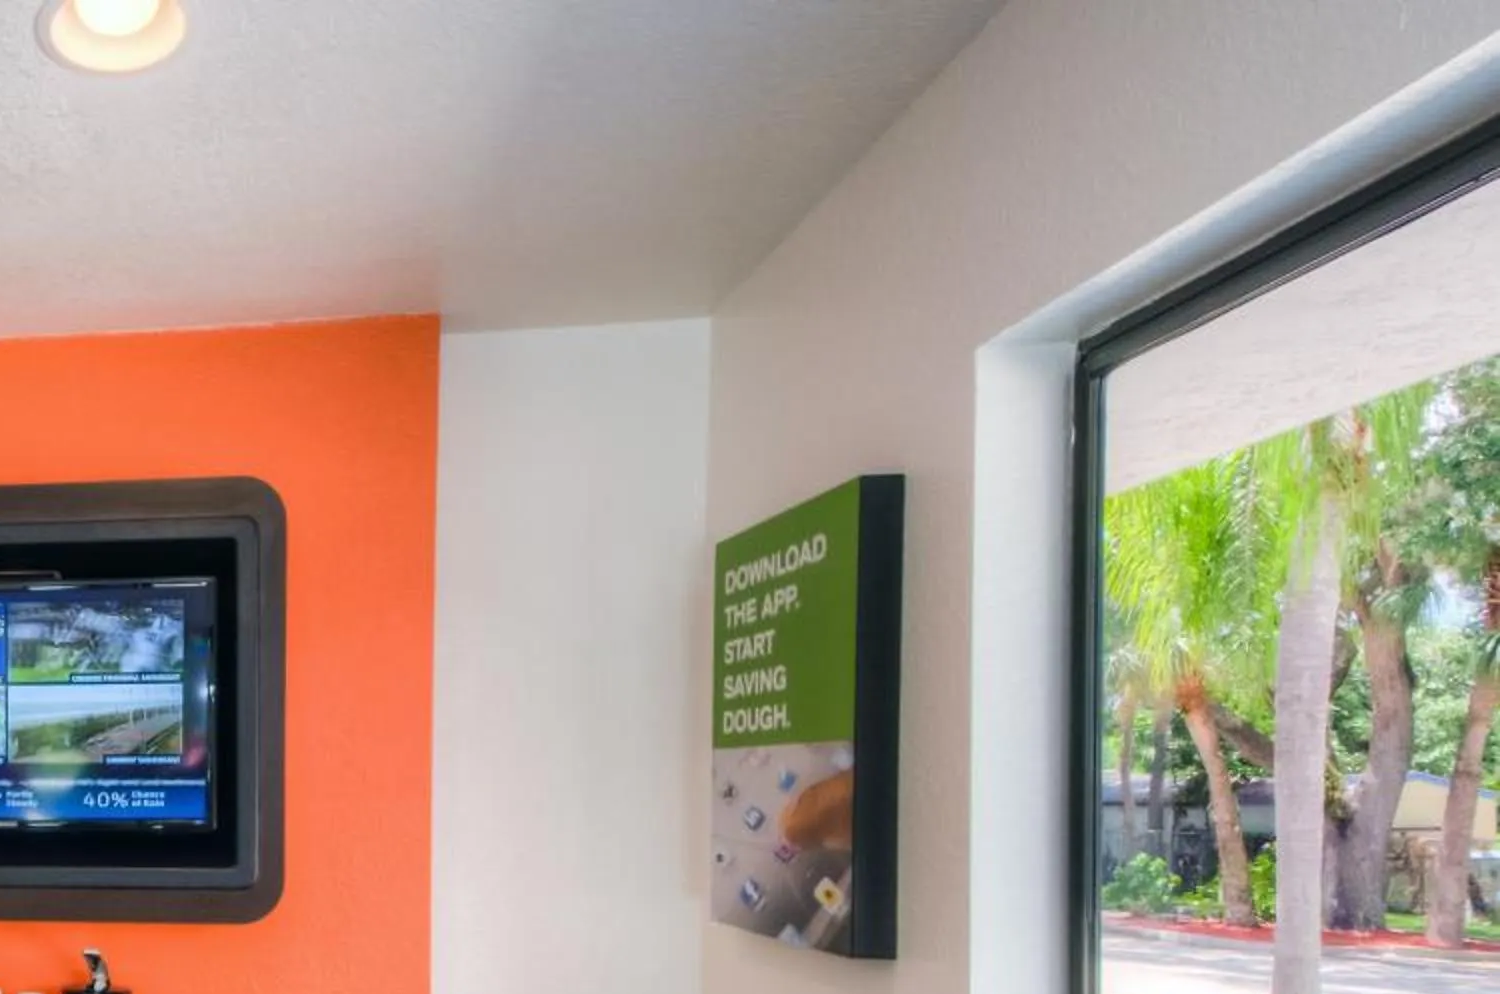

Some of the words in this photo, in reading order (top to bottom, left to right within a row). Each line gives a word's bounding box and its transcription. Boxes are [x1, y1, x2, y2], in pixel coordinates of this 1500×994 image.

[725, 533, 828, 594] DOWNLOAD
[724, 596, 758, 629] THE
[761, 584, 801, 620] APP.
[724, 630, 776, 665] START
[723, 665, 788, 700] SAVING
[723, 703, 792, 734] DOUGH.
[83, 791, 129, 808] 40%
